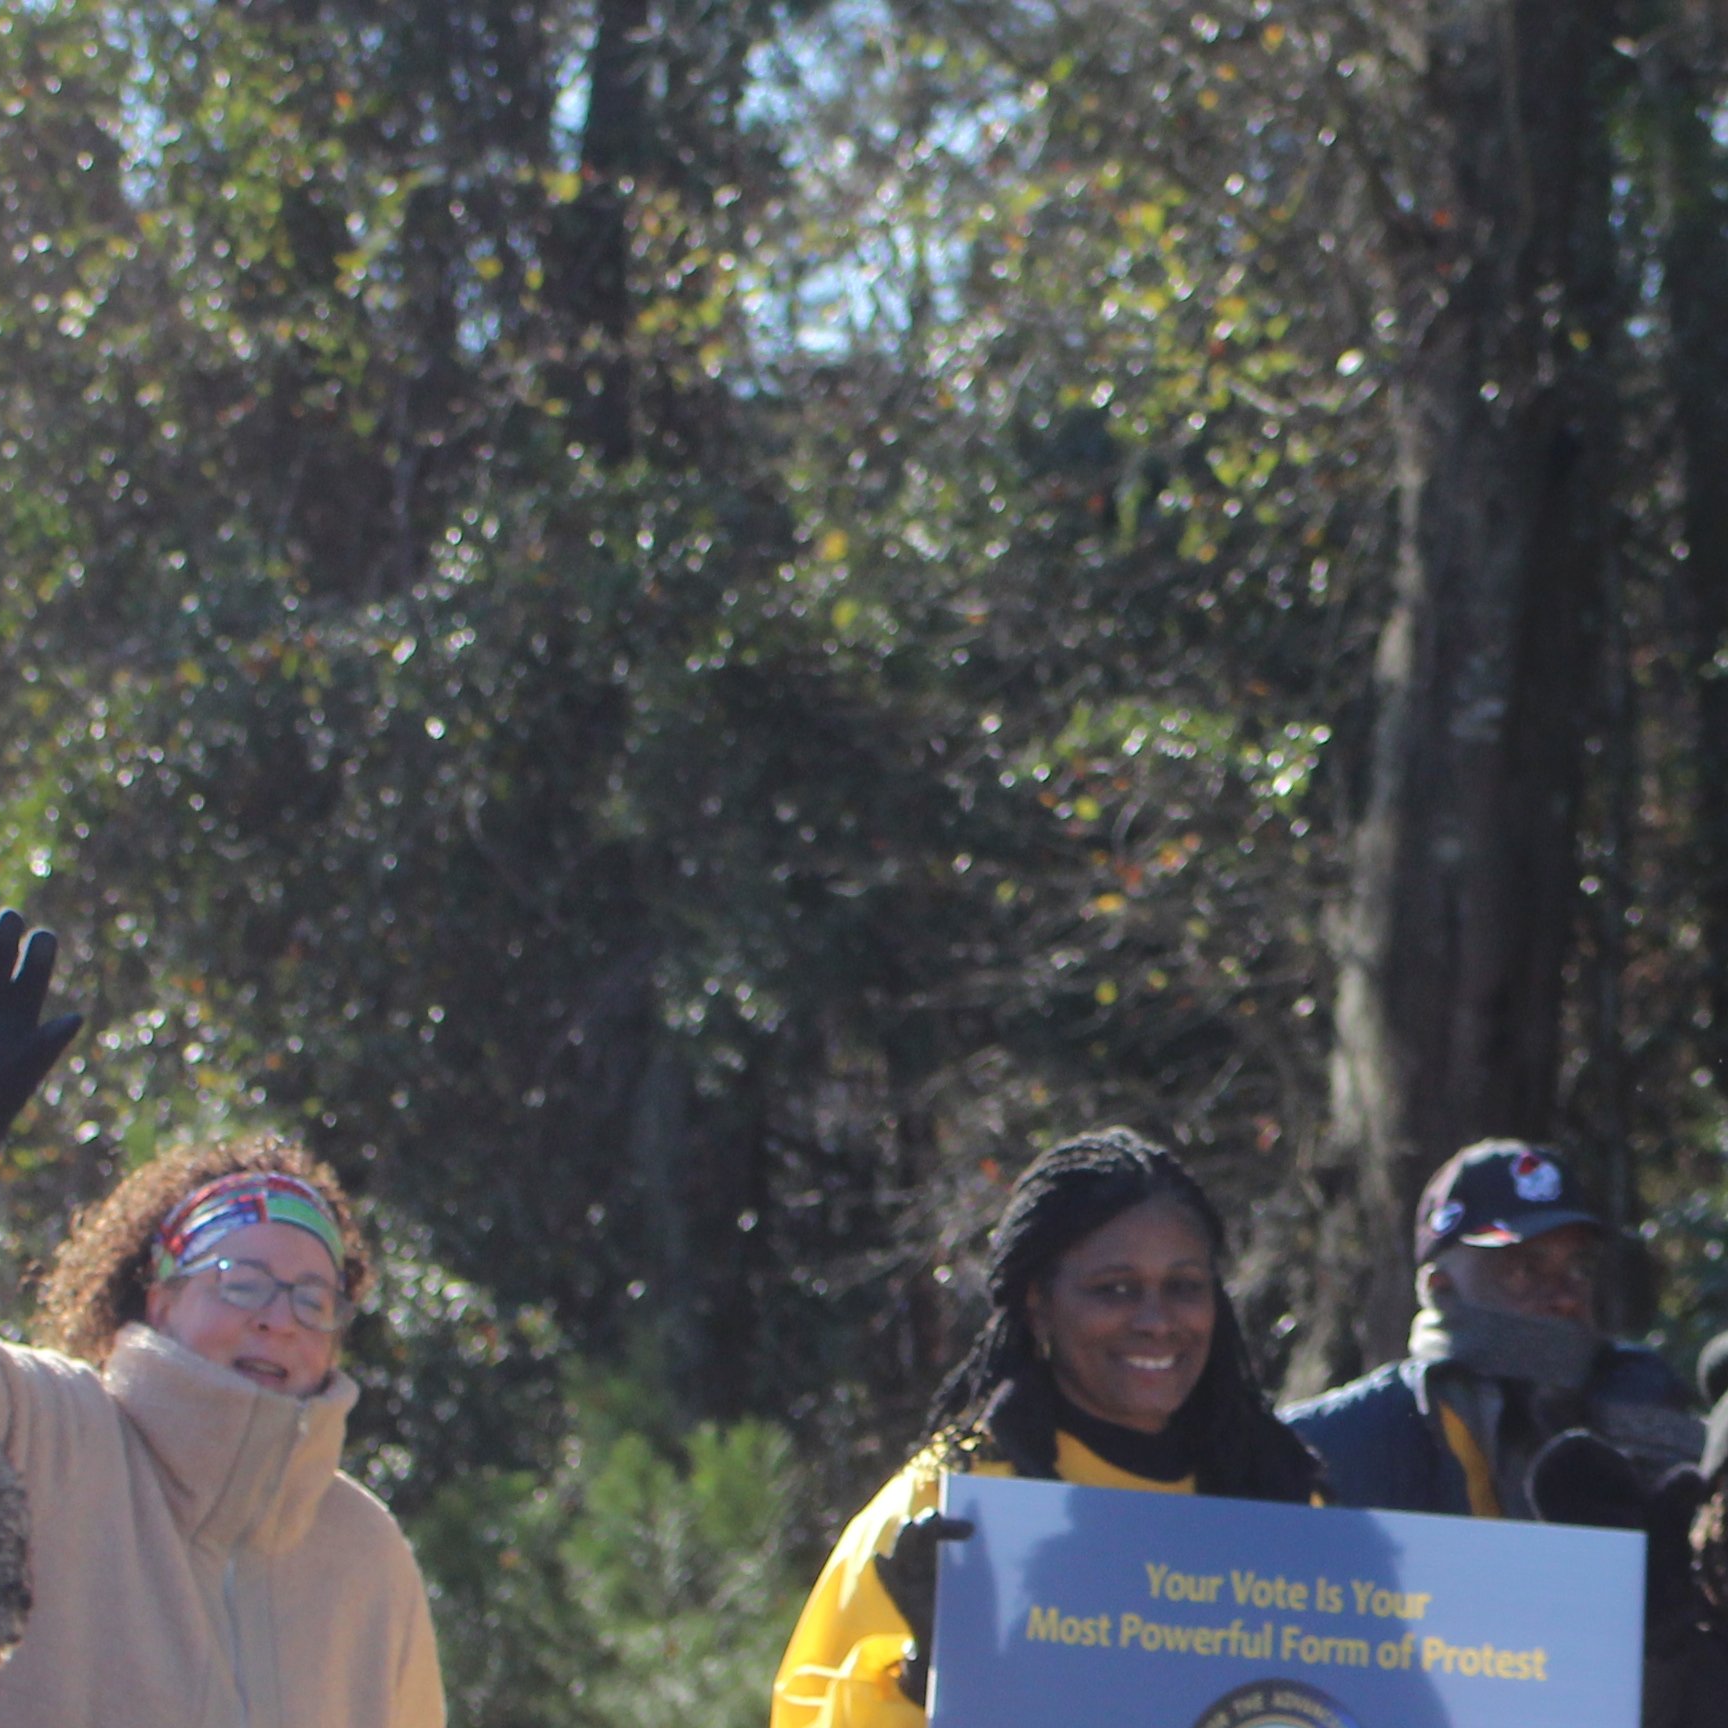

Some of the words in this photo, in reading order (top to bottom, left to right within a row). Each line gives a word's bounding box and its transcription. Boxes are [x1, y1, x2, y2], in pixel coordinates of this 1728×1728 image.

[1146, 1562, 1223, 1603] Your
[1231, 1569, 1309, 1611] Vote
[1316, 1577, 1343, 1614] Is
[1351, 1579, 1432, 1619] Your
[1026, 1605, 1112, 1648] Most
[1119, 1612, 1273, 1660] Powerful
[1280, 1625, 1369, 1667] Form
[1376, 1632, 1415, 1669] of
[1422, 1636, 1547, 1681] Protest
